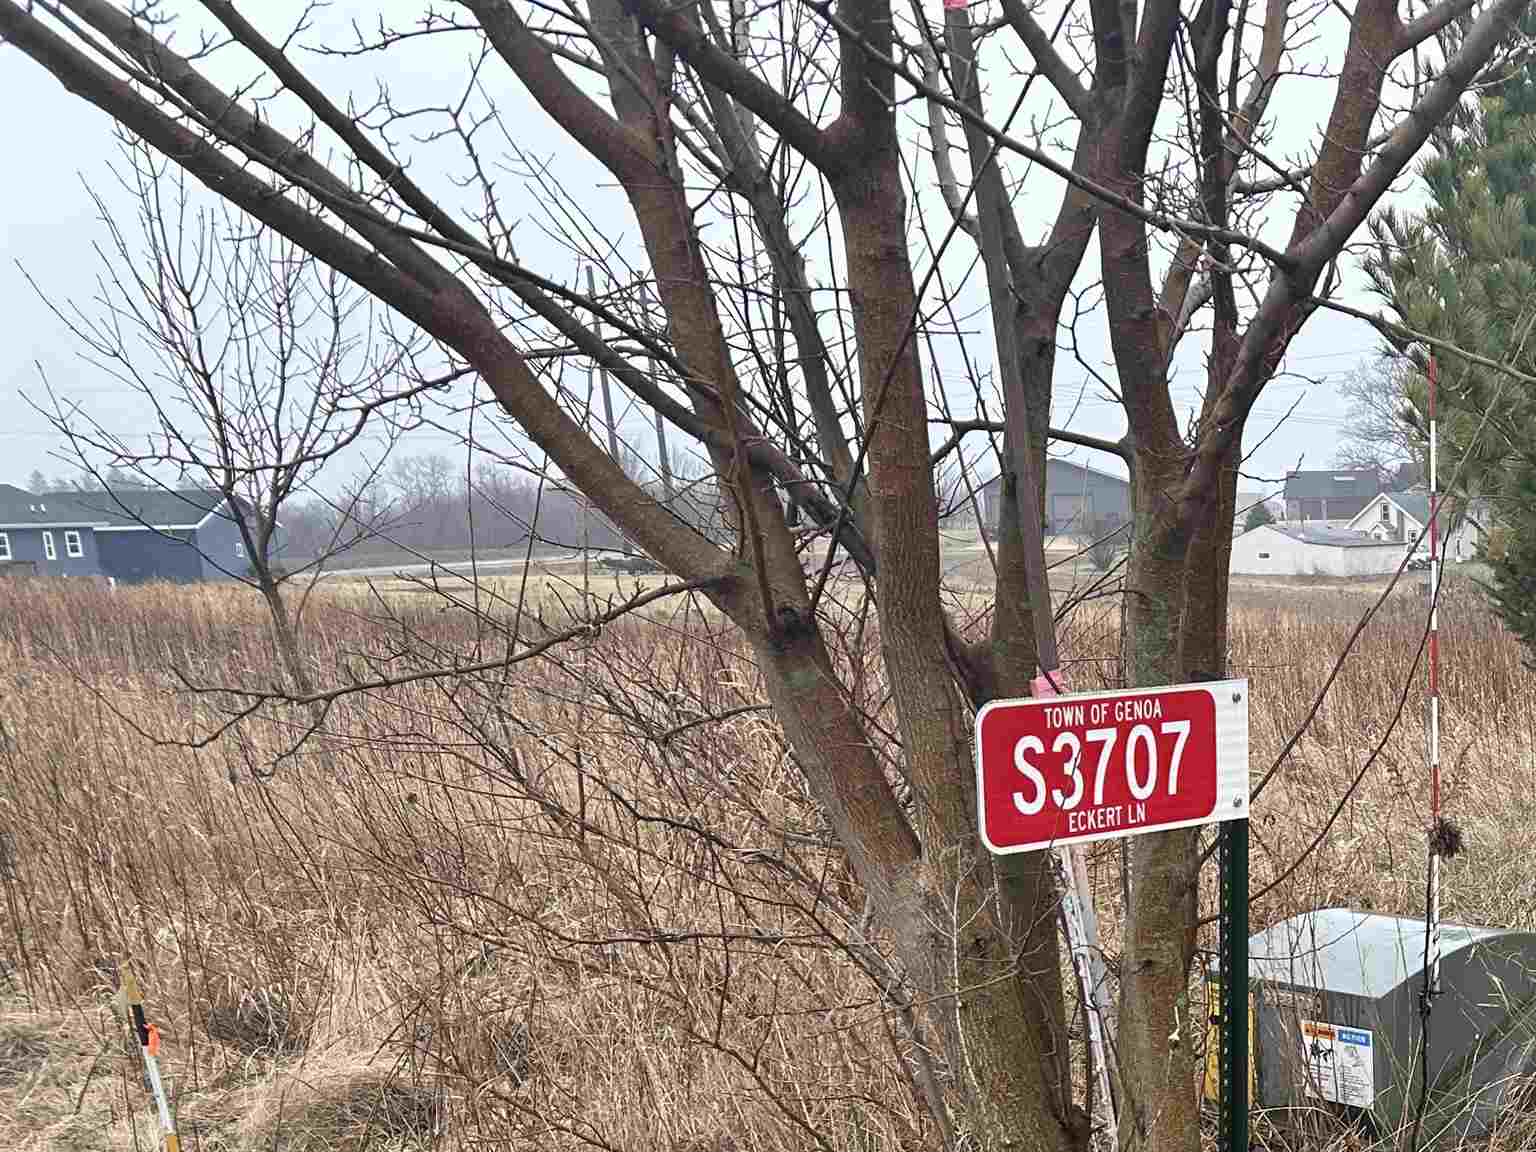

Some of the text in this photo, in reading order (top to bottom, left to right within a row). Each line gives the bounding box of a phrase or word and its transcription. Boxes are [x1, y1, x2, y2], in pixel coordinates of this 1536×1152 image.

[1044, 698, 1163, 729] TOWN OF GENOA
[1011, 719, 1191, 816] S3707
[1068, 803, 1146, 833] ECKERT LN
